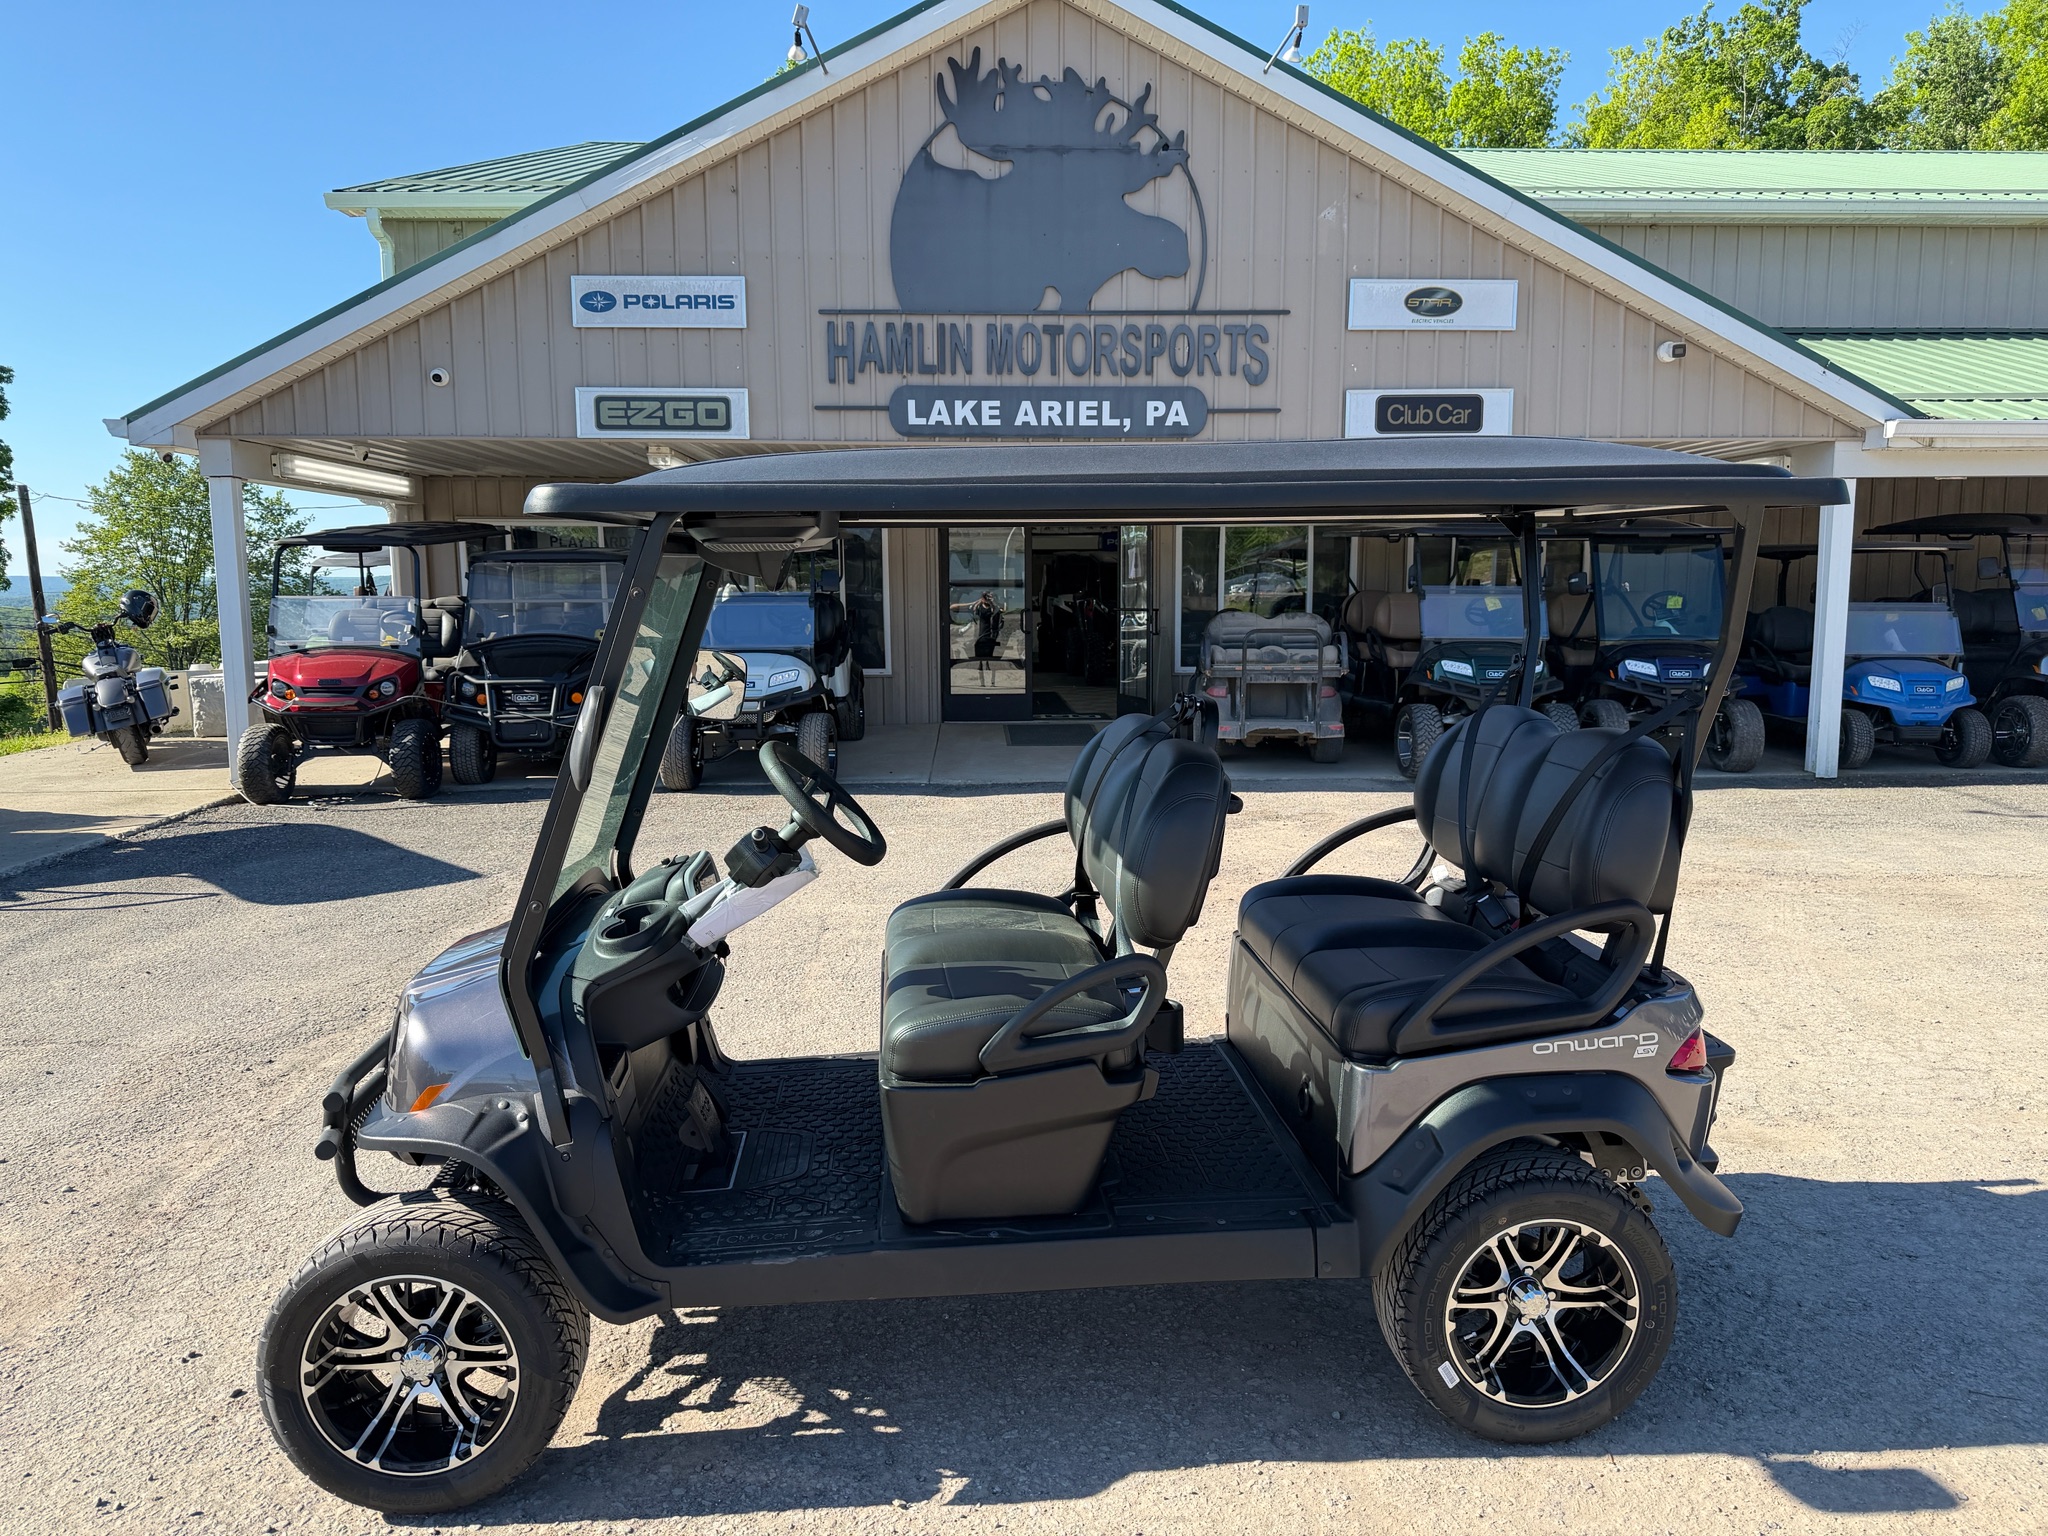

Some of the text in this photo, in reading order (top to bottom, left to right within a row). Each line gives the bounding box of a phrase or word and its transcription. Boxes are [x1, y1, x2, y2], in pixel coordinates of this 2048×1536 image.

[623, 294, 735, 309] POLARIS
[1407, 298, 1452, 307] STAR
[827, 320, 1270, 387] HAMLIN MOTORSPORTS
[599, 400, 727, 426] EZGO
[906, 399, 1190, 433] LAKE ARIEL, PA
[1387, 403, 1472, 425] Club Car
[549, 535, 585, 548] PLAY
[1636, 1047, 1656, 1055] LSV
